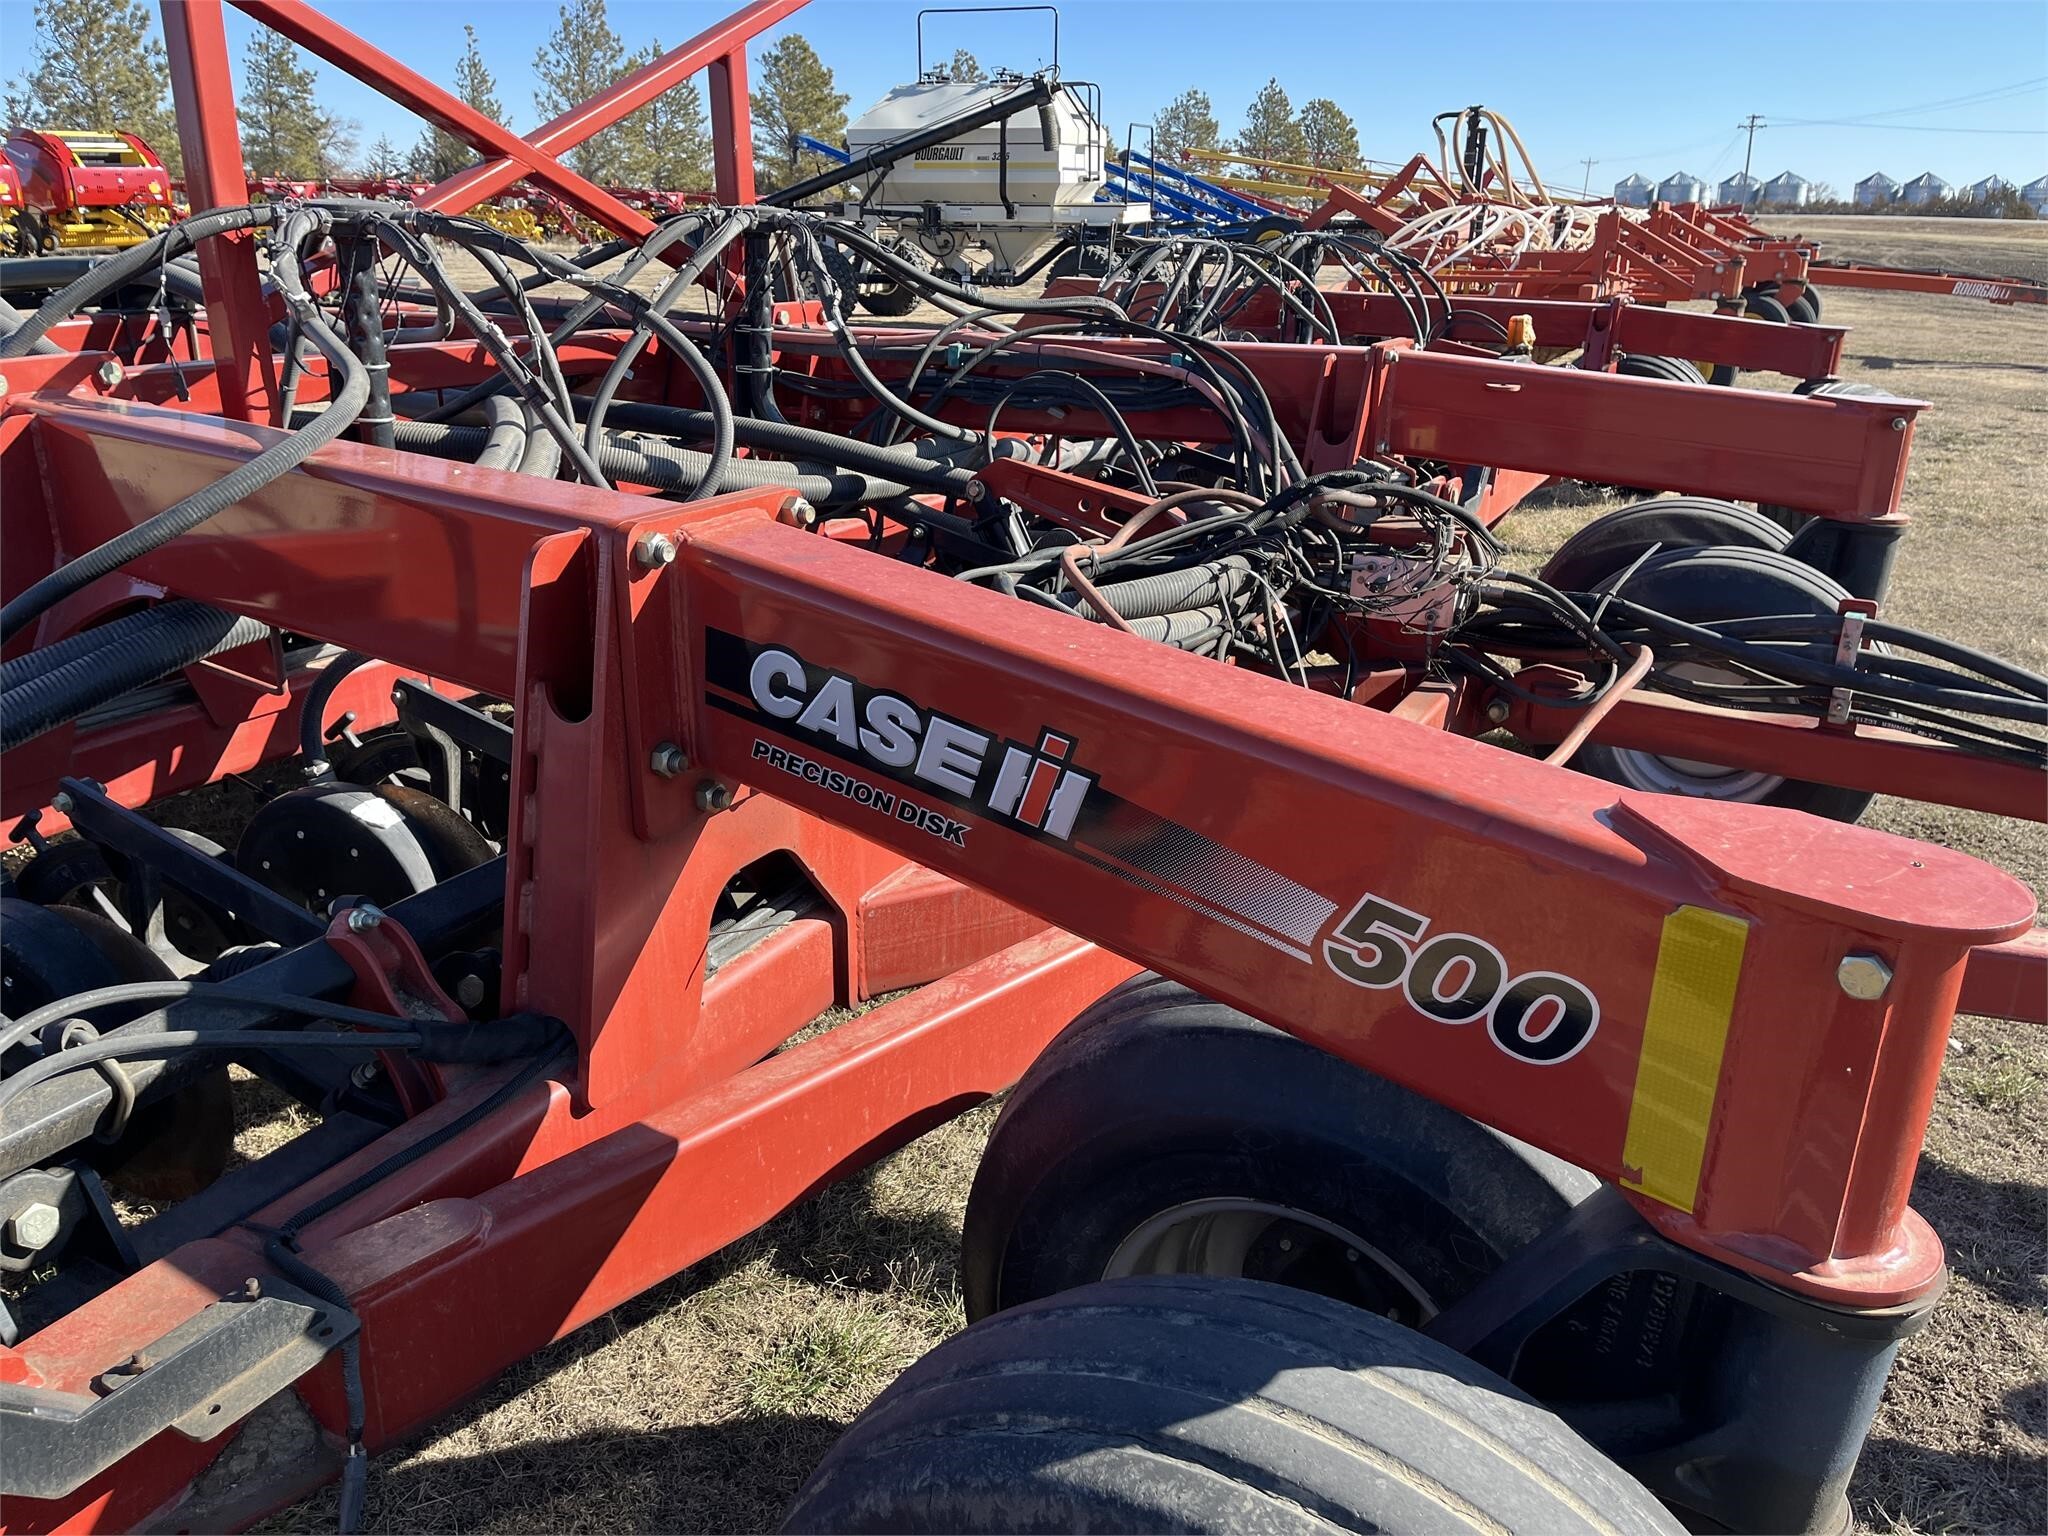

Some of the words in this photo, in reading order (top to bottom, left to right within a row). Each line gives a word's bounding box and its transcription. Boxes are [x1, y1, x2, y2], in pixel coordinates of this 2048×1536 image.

[915, 147, 965, 161] BOURGAULT
[749, 649, 990, 799] CASE
[751, 738, 895, 815] PRECISION
[895, 799, 973, 848] DISK
[1322, 892, 1601, 1066] 500
